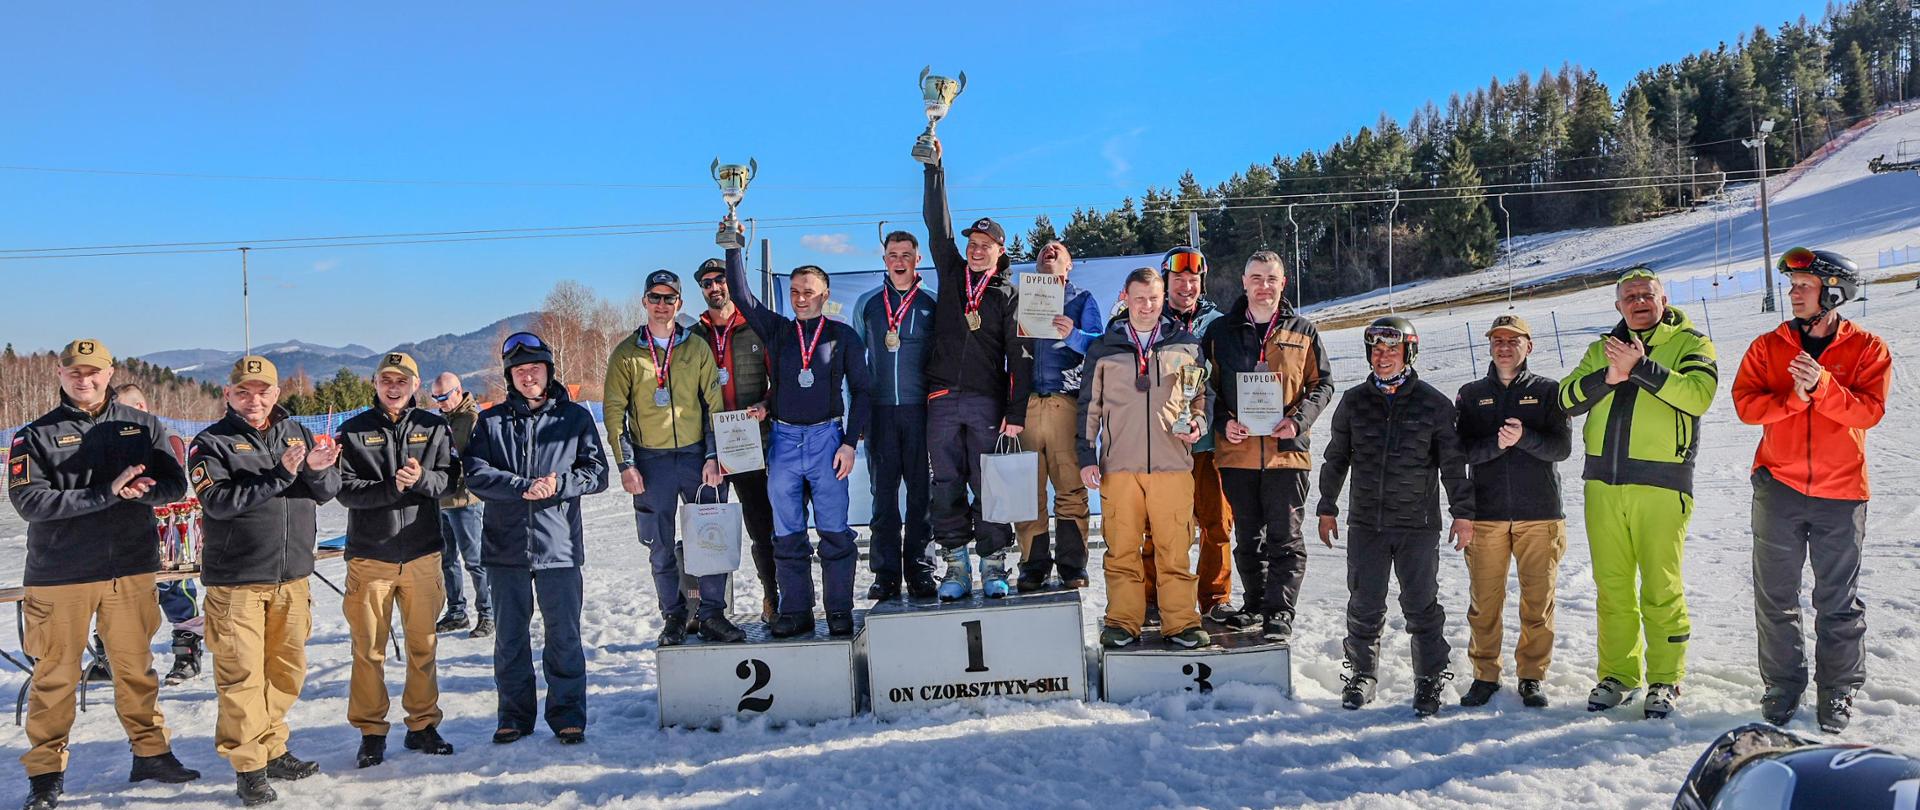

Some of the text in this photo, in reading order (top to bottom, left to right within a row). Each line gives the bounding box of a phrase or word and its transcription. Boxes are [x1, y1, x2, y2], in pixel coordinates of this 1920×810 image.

[1026, 275, 1059, 285] DYPLOM
[1243, 374, 1276, 384] DYPLOM
[961, 619, 989, 673] 1
[735, 658, 774, 713] 2
[1182, 662, 1213, 694] 3
[889, 686, 915, 703] ON
